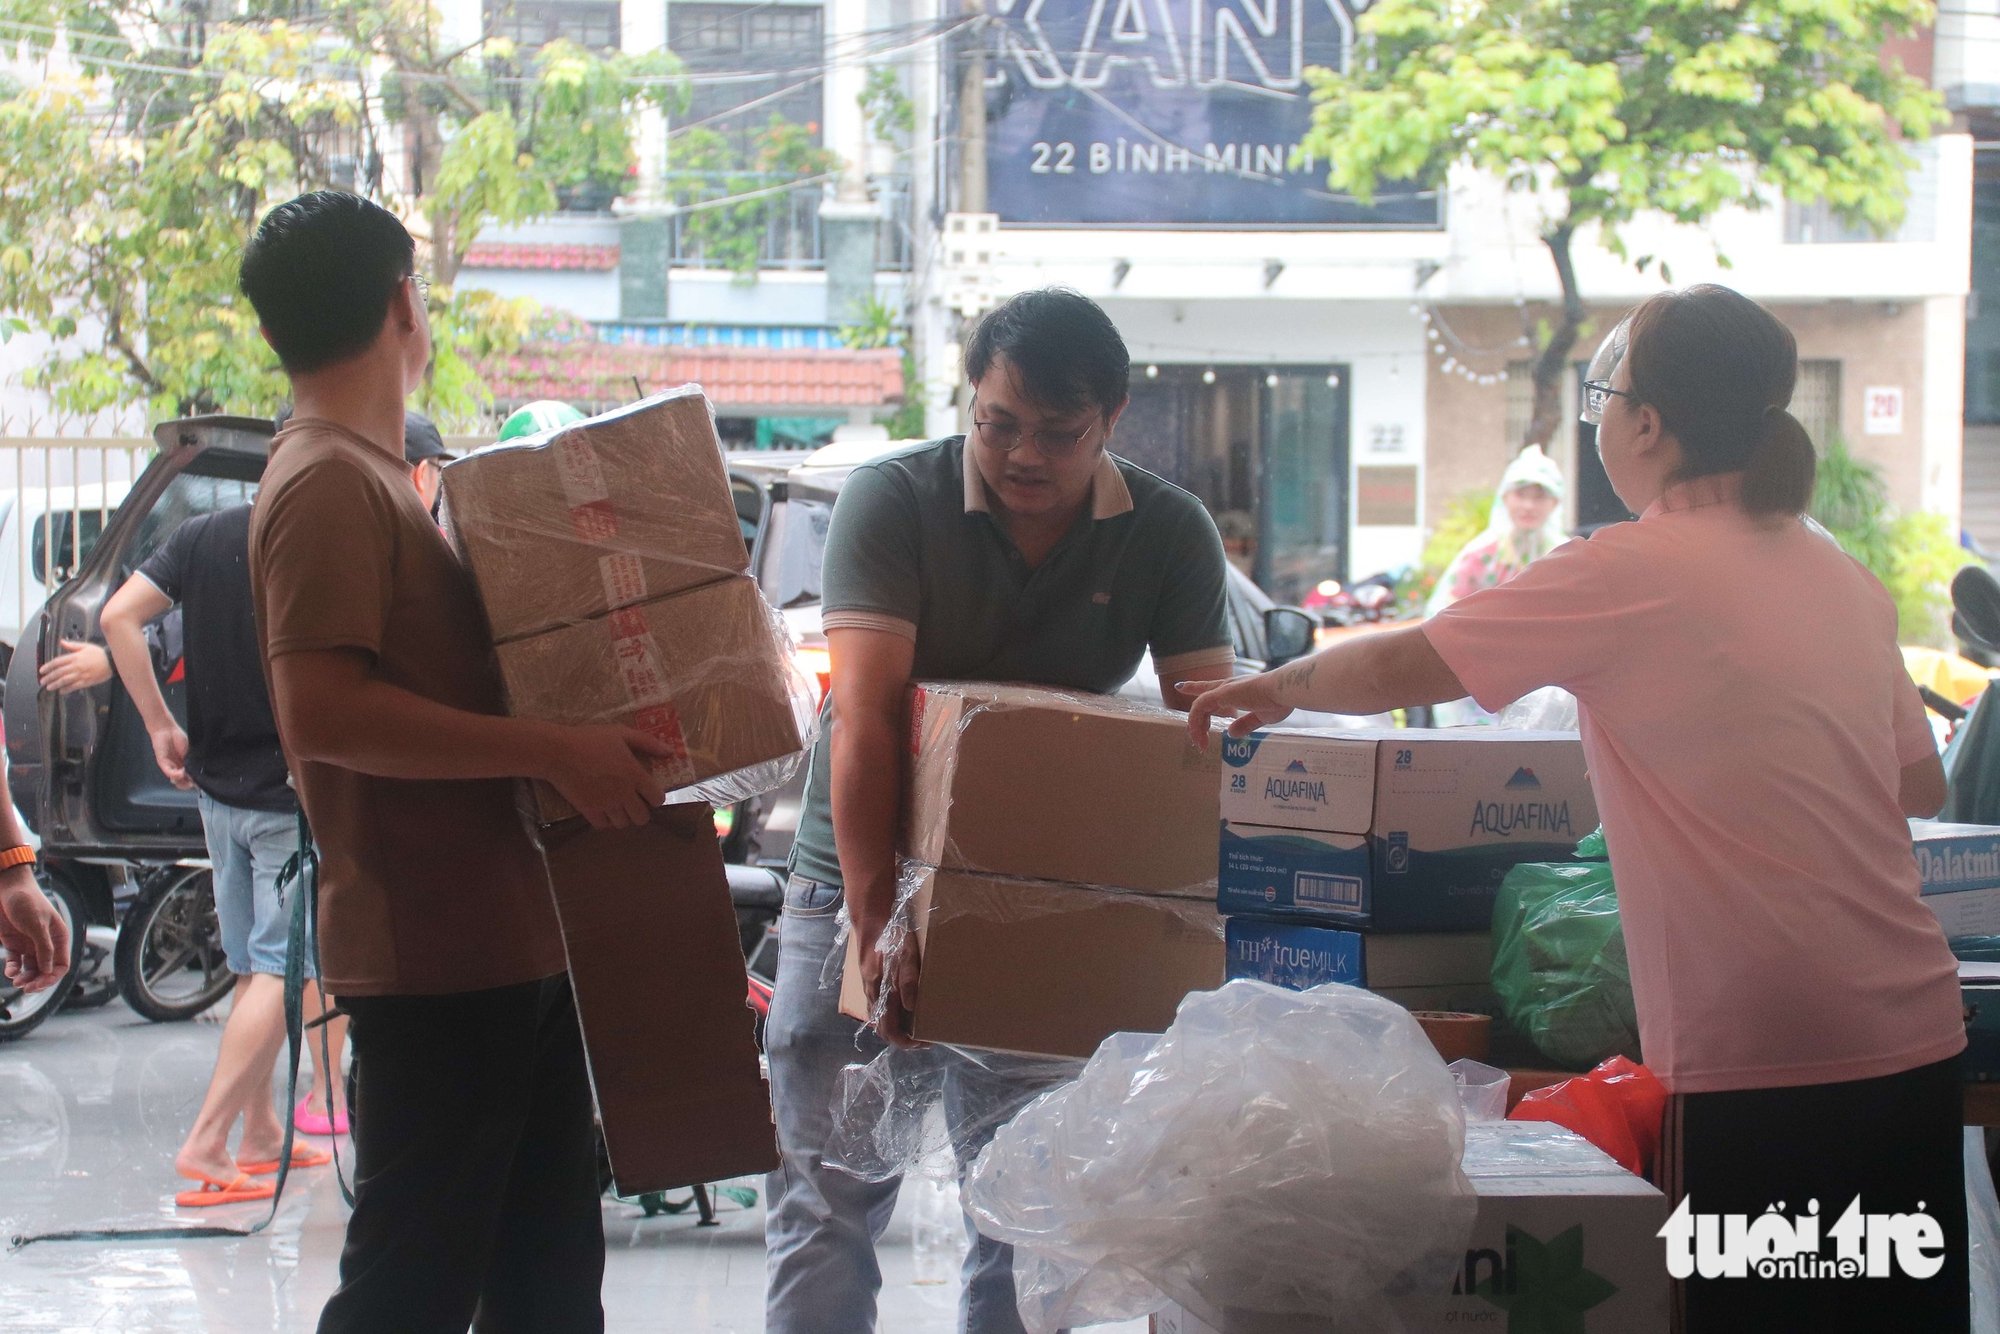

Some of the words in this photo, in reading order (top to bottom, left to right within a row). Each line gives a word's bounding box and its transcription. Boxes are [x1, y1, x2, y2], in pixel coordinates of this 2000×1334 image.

[1030, 141, 1076, 174] 22
[1089, 137, 1189, 174] BÌNH
[1370, 424, 1404, 444] 22
[1395, 750, 1412, 764] 28
[1231, 774, 1246, 788] 28
[1263, 776, 1327, 806] AQUAFINA
[1470, 800, 1573, 838] AQUAFINA
[1917, 842, 2000, 883] Dalatmi
[1237, 940, 1260, 962] TH
[1461, 1309, 1498, 1322] nước
